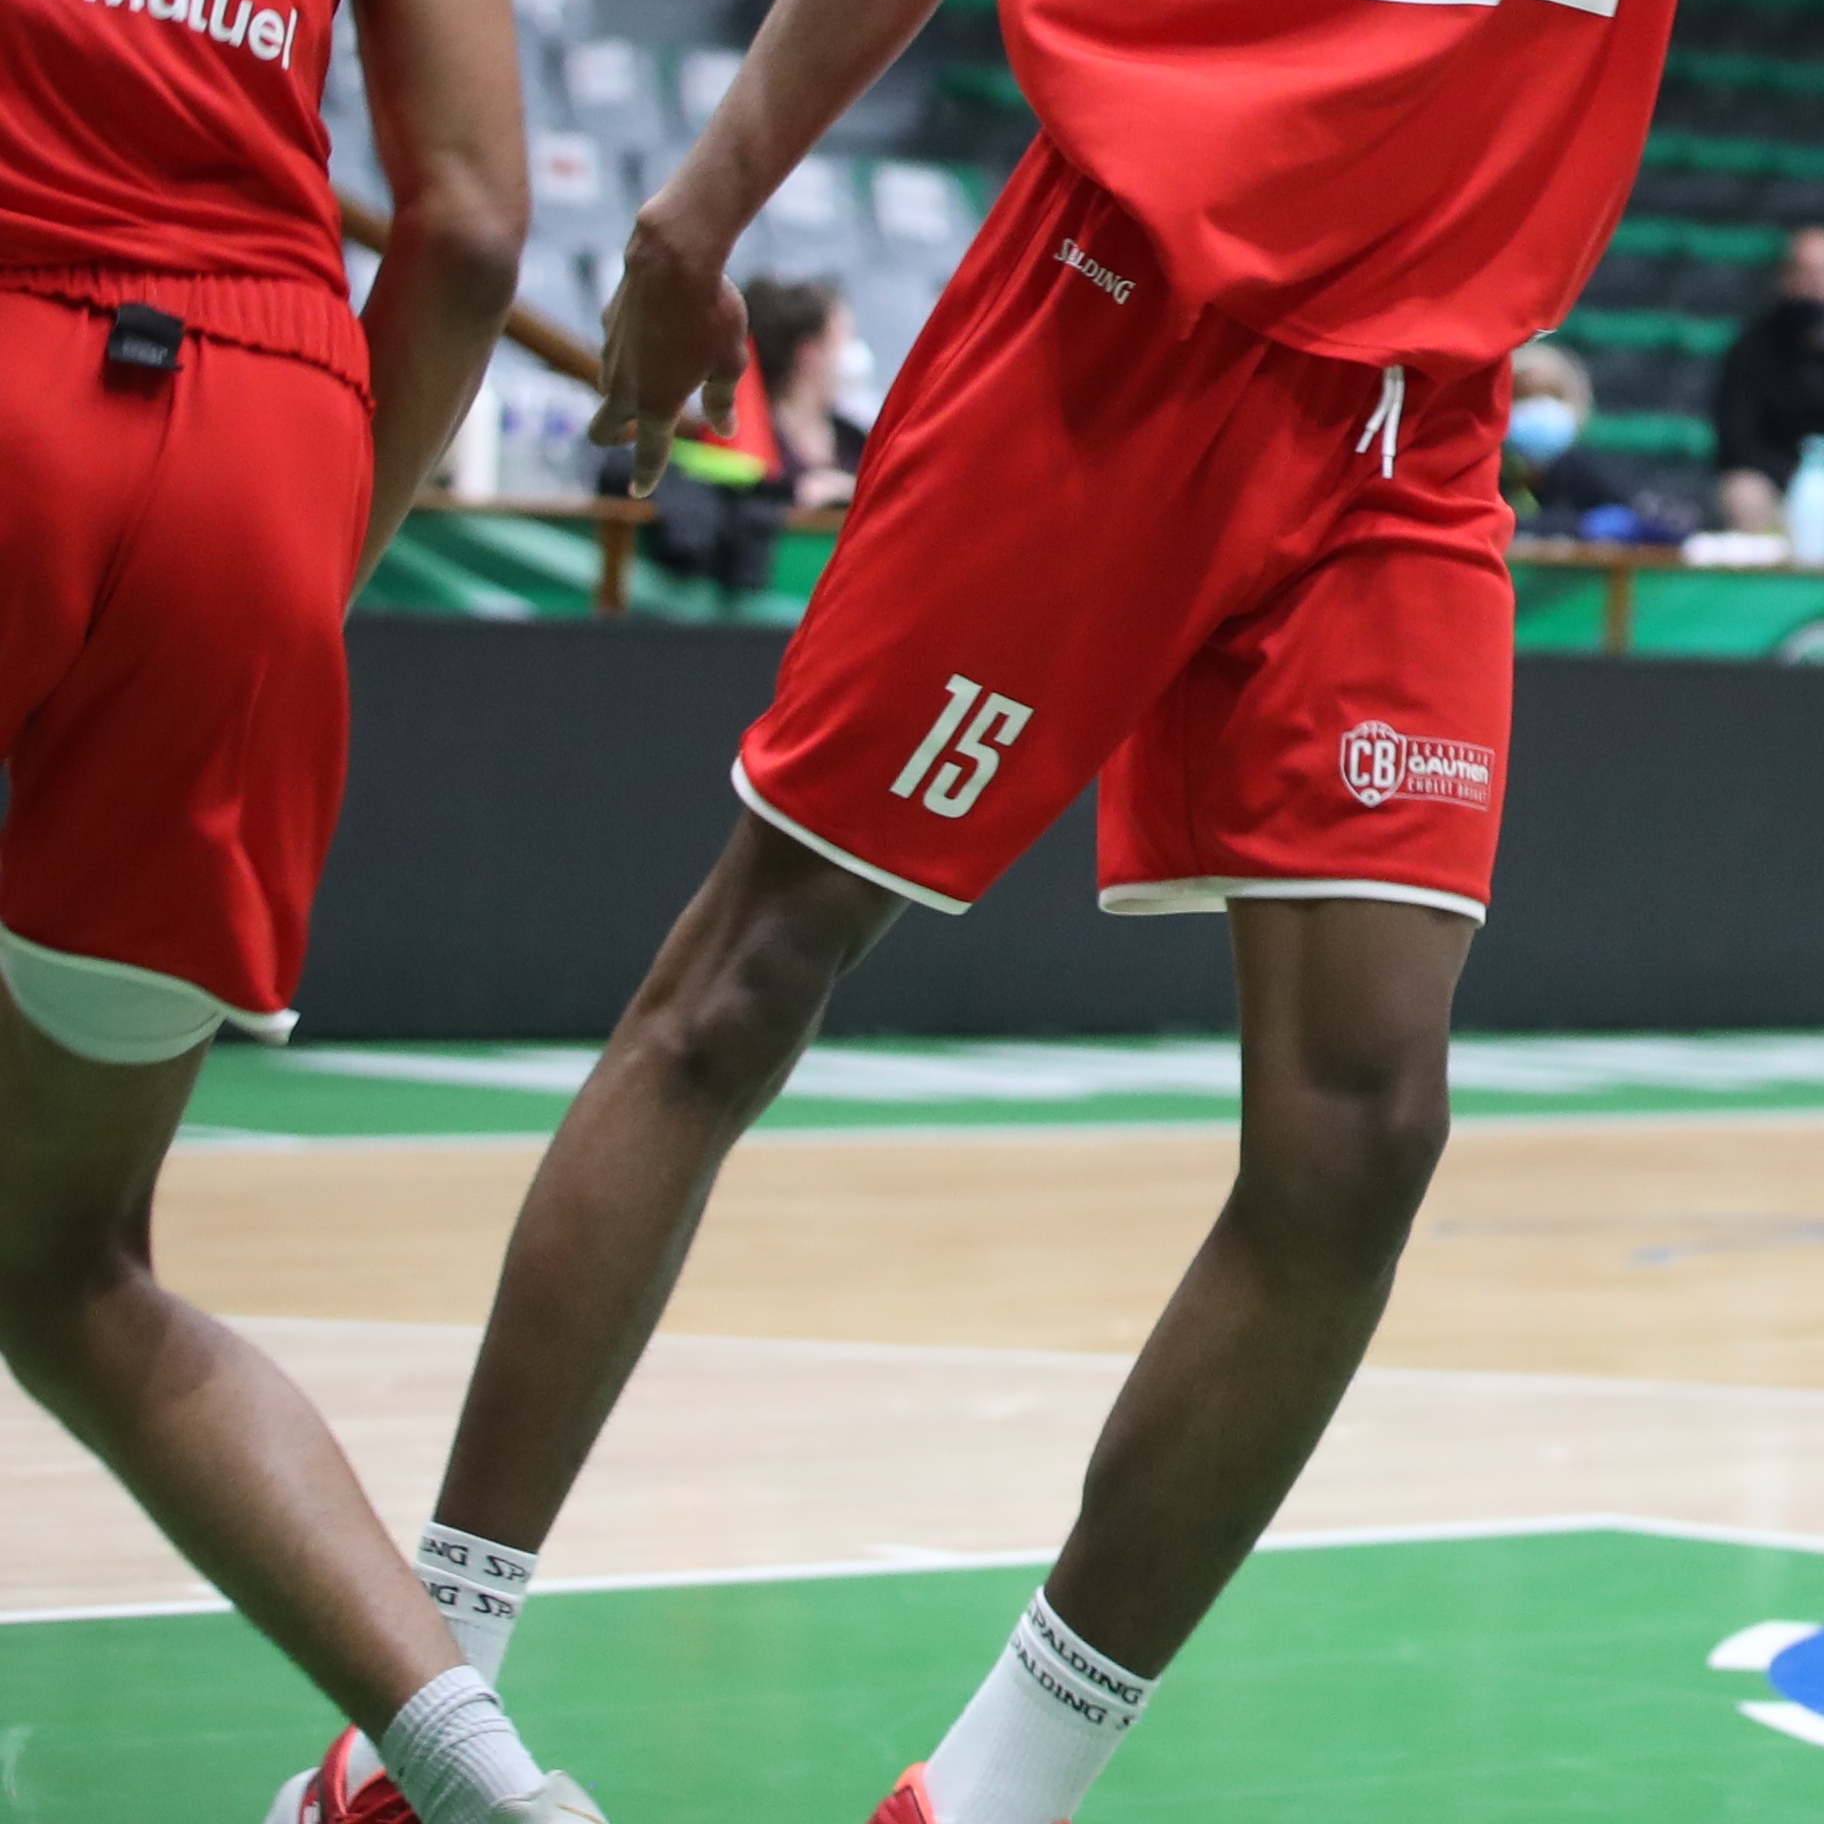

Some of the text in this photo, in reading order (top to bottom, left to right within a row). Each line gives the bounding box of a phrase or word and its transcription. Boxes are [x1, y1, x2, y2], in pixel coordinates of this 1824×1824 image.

[889, 673, 1034, 819] 15
[1351, 739, 1397, 788] CB
[483, 1555, 532, 1583] SP
[472, 1593, 517, 1619] SP
[1026, 1604, 1143, 1705] PALDING
